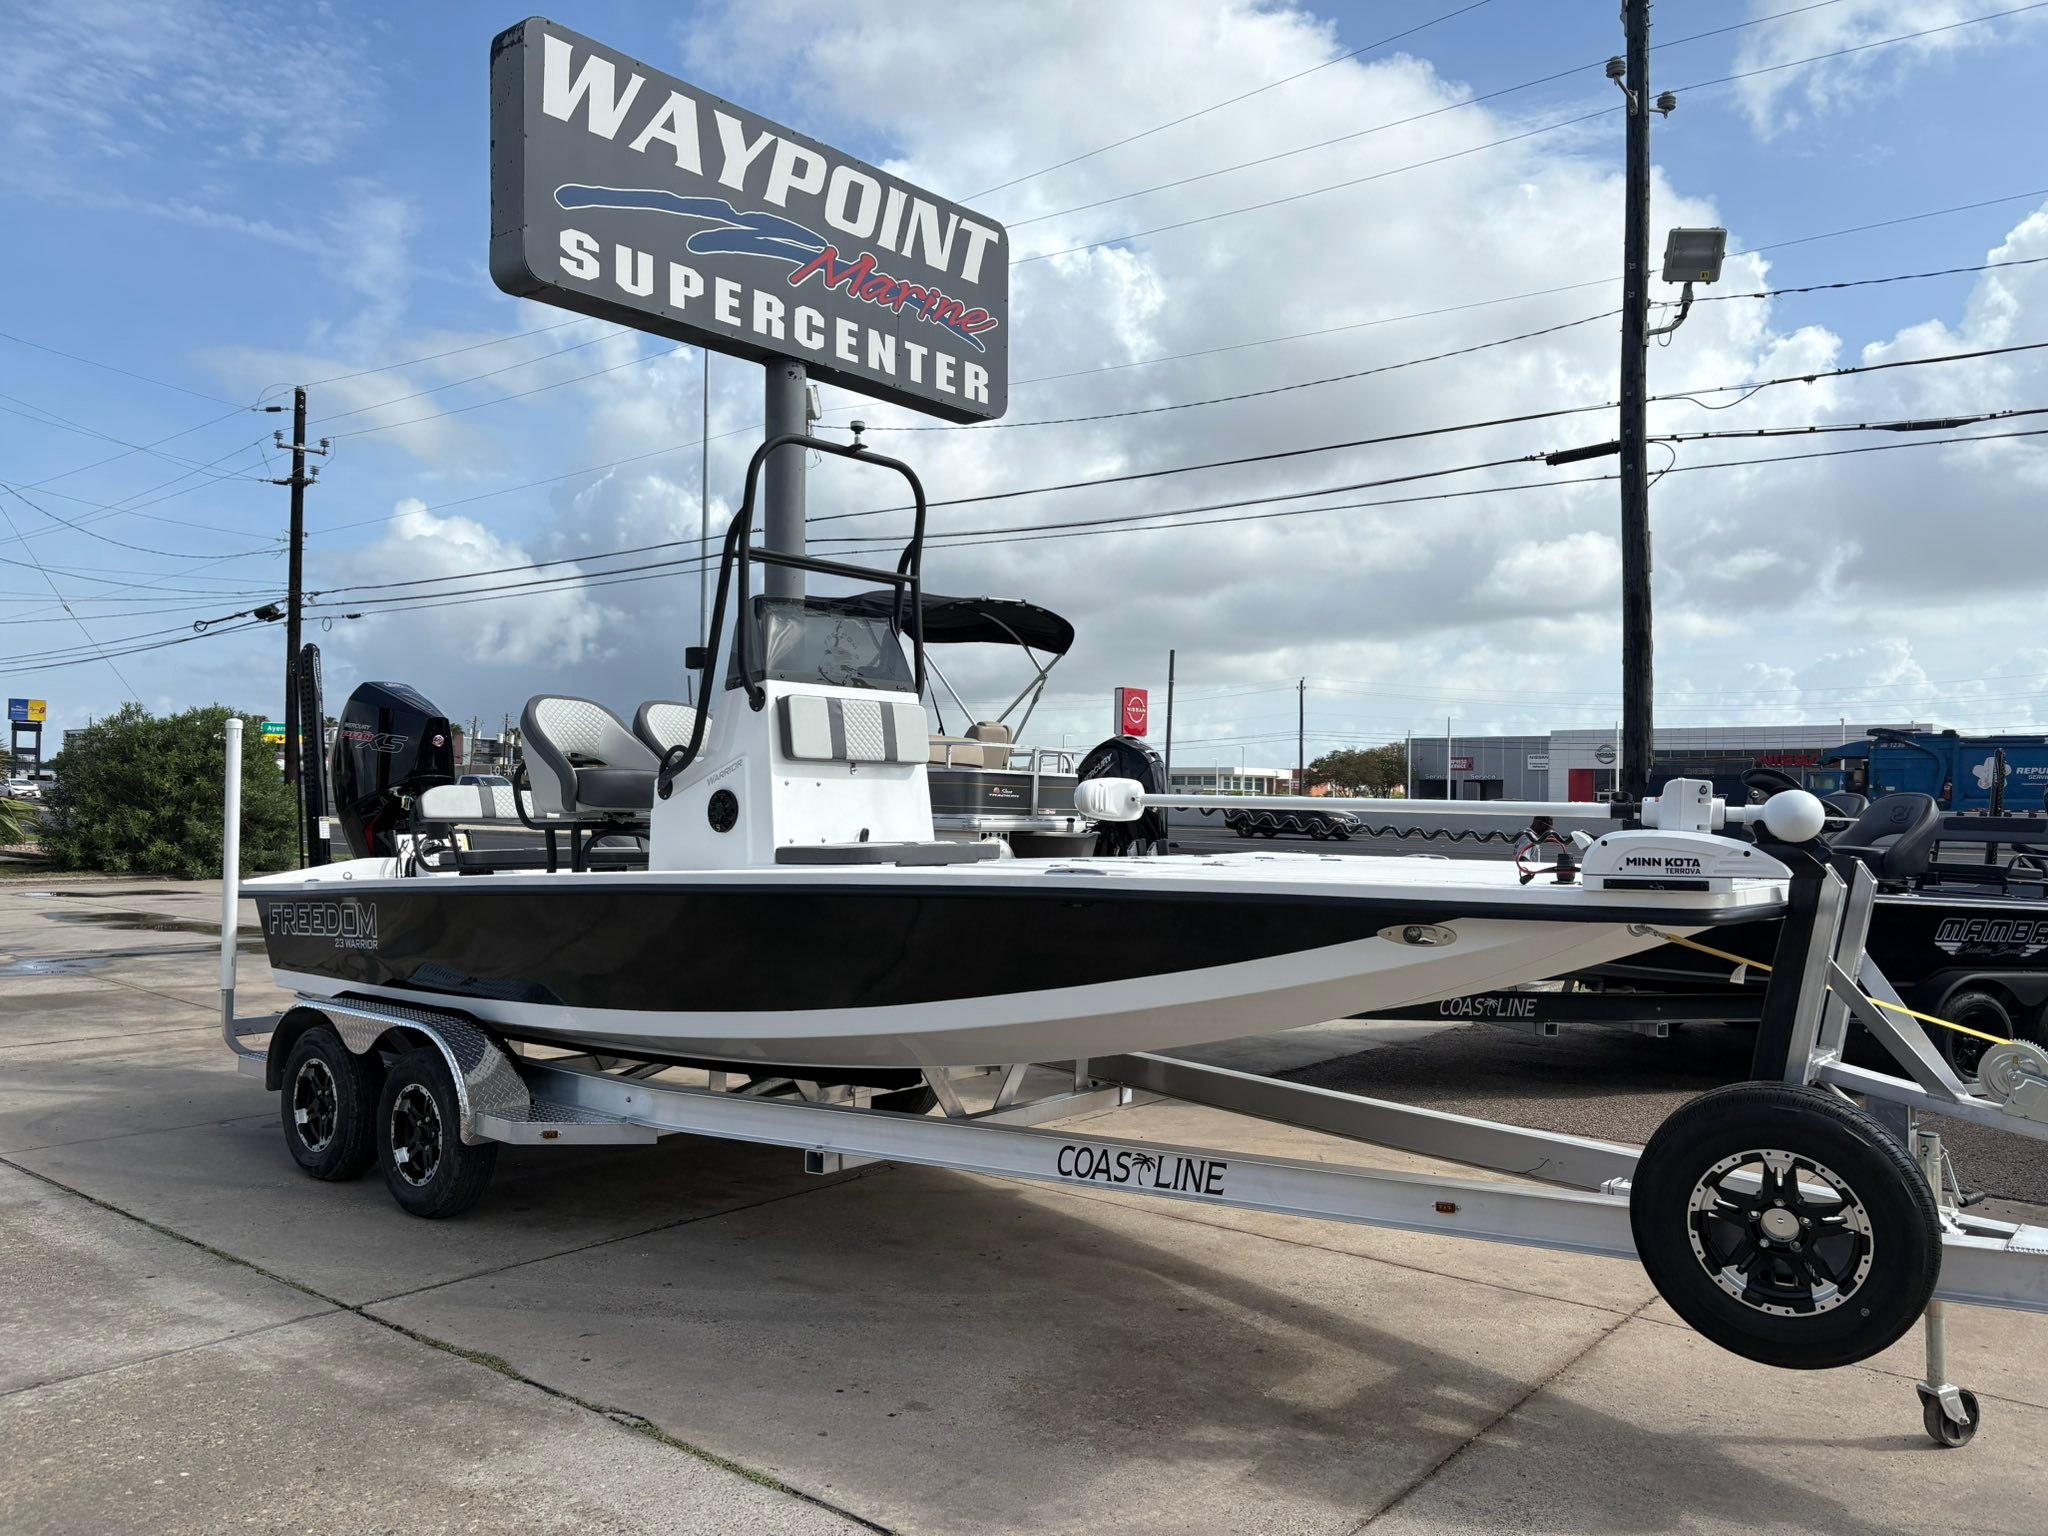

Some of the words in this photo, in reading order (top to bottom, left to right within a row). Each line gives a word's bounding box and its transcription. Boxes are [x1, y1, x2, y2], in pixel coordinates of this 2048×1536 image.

[543, 33, 999, 285] WAYPOINT
[788, 245, 999, 335] Marine
[559, 228, 989, 404] SUPERCENTER
[355, 733, 409, 754] XS
[706, 758, 743, 786] WARRIOR
[1084, 752, 1113, 780] ERCURY
[2016, 767, 2048, 775] REPU
[1626, 857, 1661, 867] MINN
[1665, 858, 1701, 867] KOTA
[269, 902, 378, 938] FREEDOM
[1934, 918, 2048, 943] MAMBA
[335, 938, 344, 948] 23
[345, 939, 378, 950] WARRIOR
